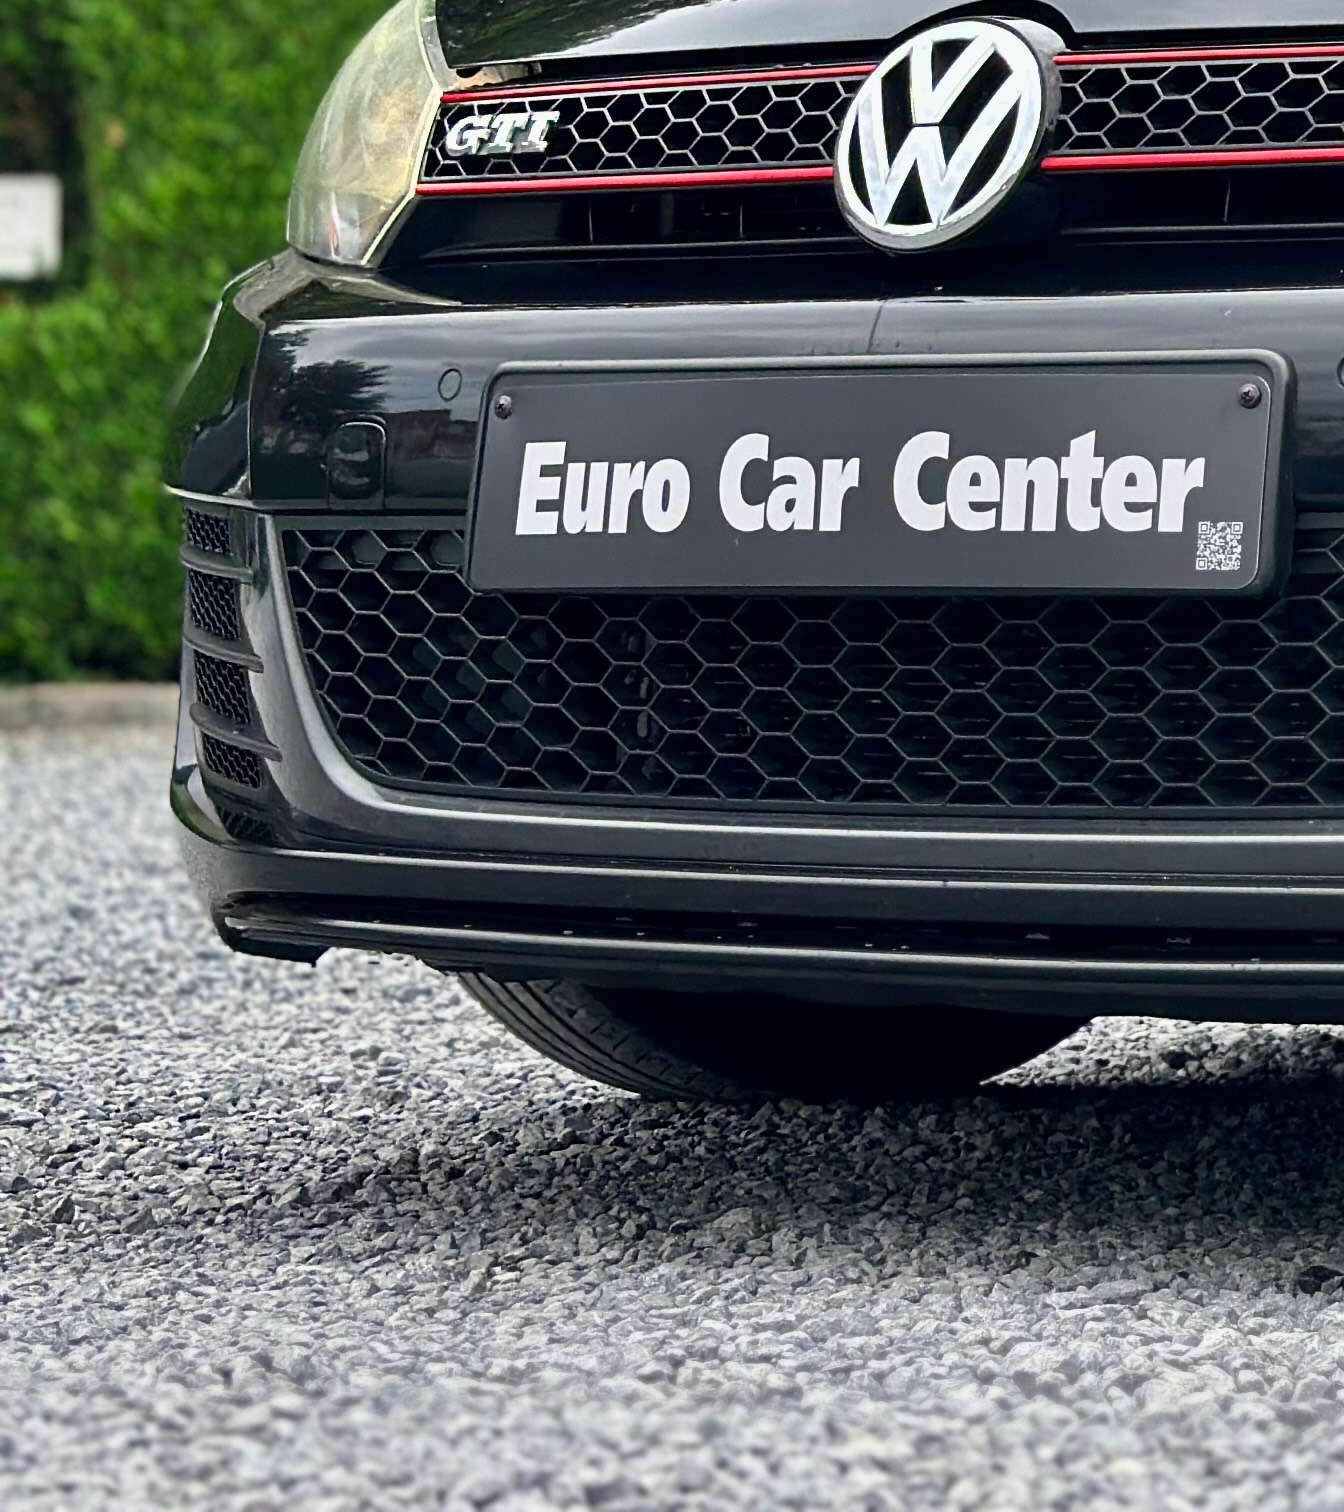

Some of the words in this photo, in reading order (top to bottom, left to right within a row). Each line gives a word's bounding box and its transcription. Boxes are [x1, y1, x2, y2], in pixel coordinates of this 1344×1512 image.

[445, 110, 560, 156] GTI
[836, 18, 1043, 240] VW
[516, 442, 690, 535] Euro
[719, 433, 860, 531] Car
[893, 430, 1205, 533] Center
